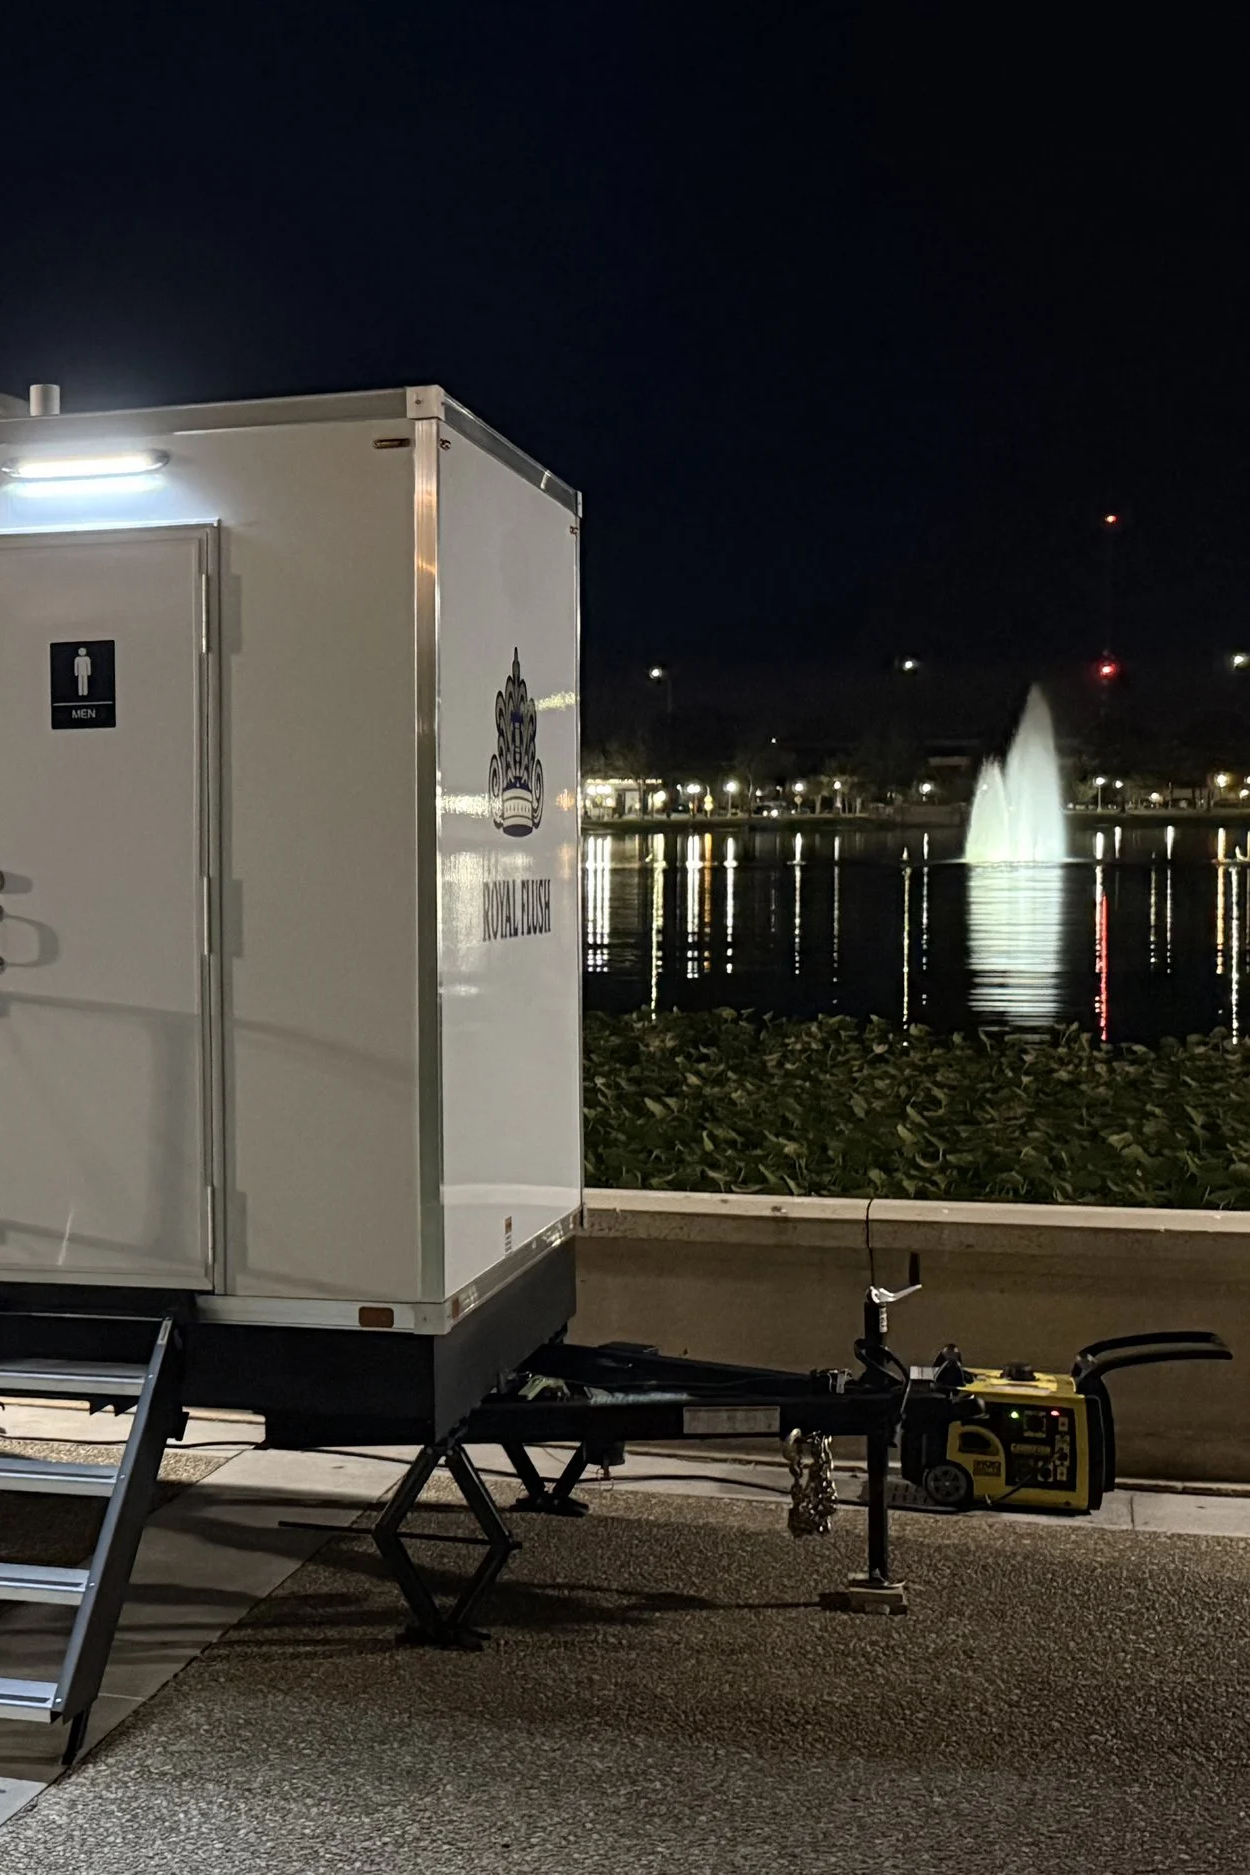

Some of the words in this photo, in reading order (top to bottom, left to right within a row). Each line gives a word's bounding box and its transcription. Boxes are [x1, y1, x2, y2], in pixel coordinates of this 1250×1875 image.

[71, 708, 96, 719] MEN
[482, 879, 518, 942] ROYAL
[521, 878, 551, 936] FLUSH
